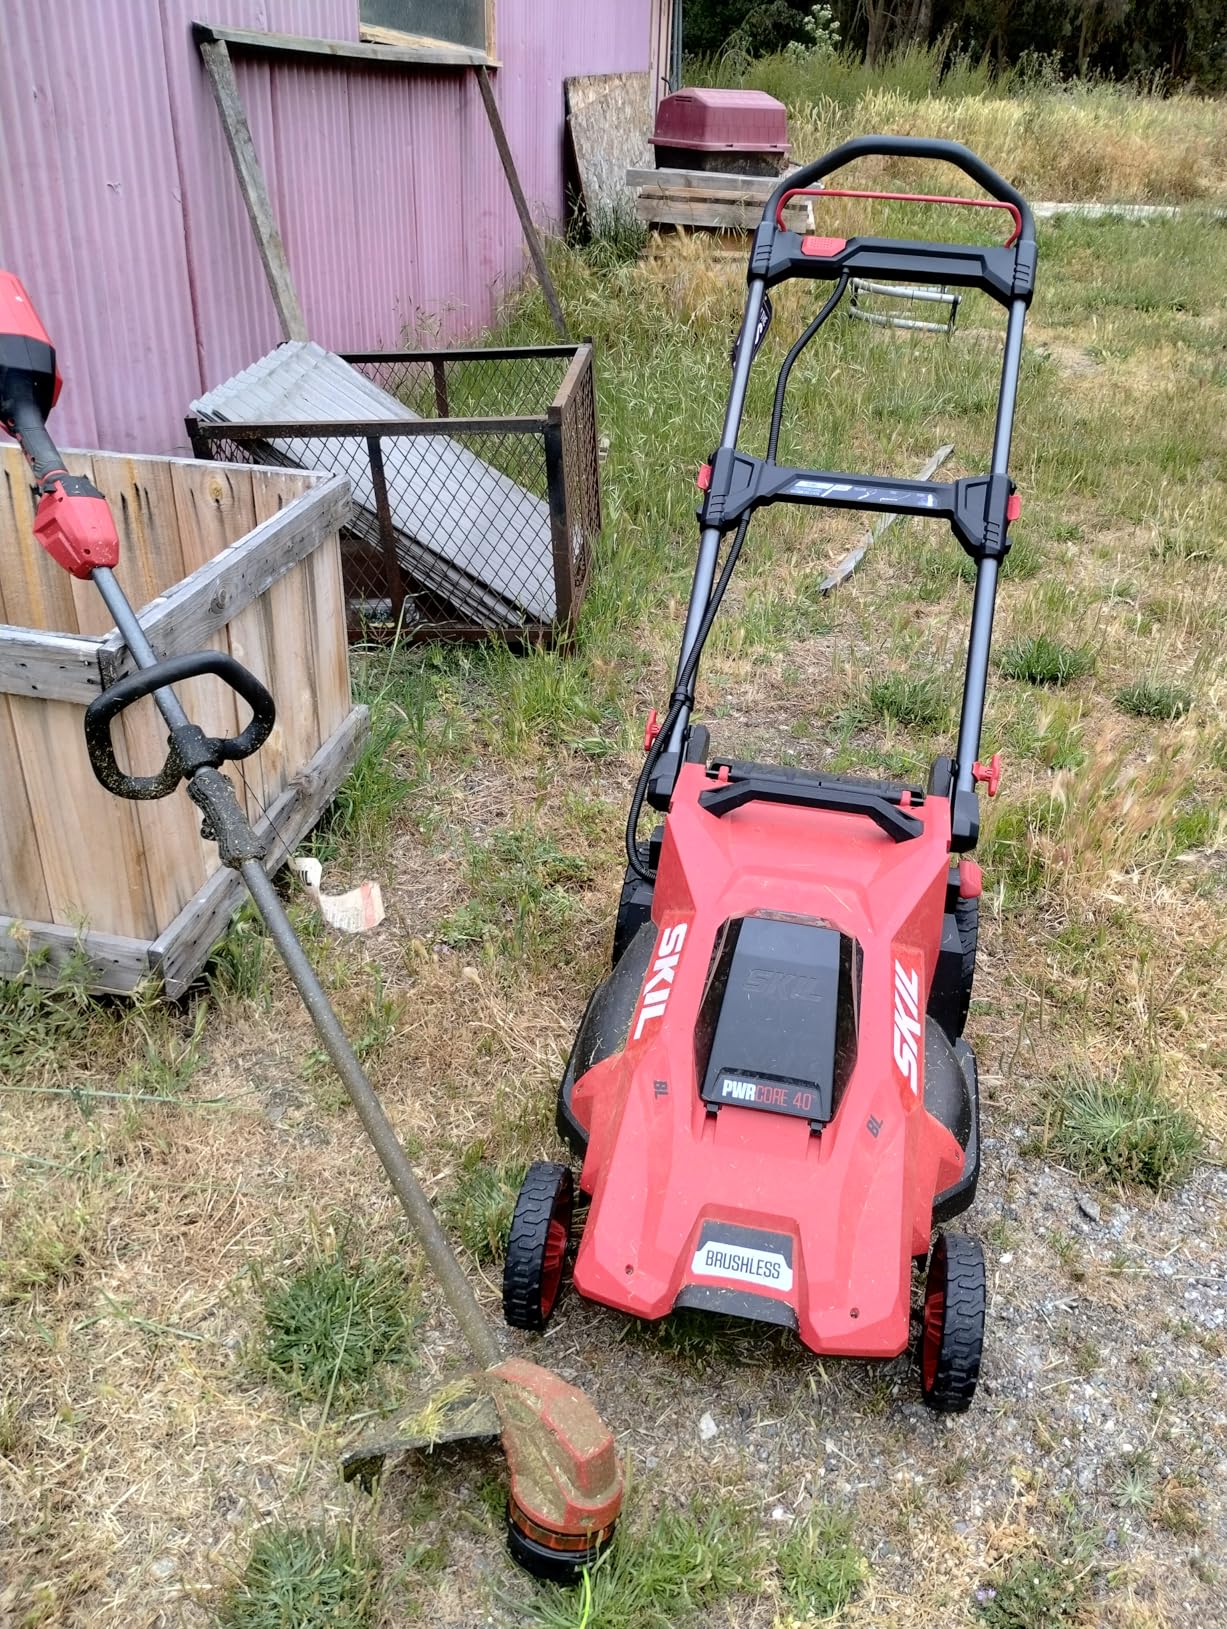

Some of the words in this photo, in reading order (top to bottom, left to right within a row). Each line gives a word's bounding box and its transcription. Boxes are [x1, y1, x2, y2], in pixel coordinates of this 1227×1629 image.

[633, 923, 688, 1040] SKIL
[893, 959, 921, 1097] SKIL
[653, 1079, 669, 1100] BL
[722, 1079, 789, 1107] PWRCORE
[866, 1114, 884, 1138] BL
[705, 1249, 781, 1280] BRUSHLESS
